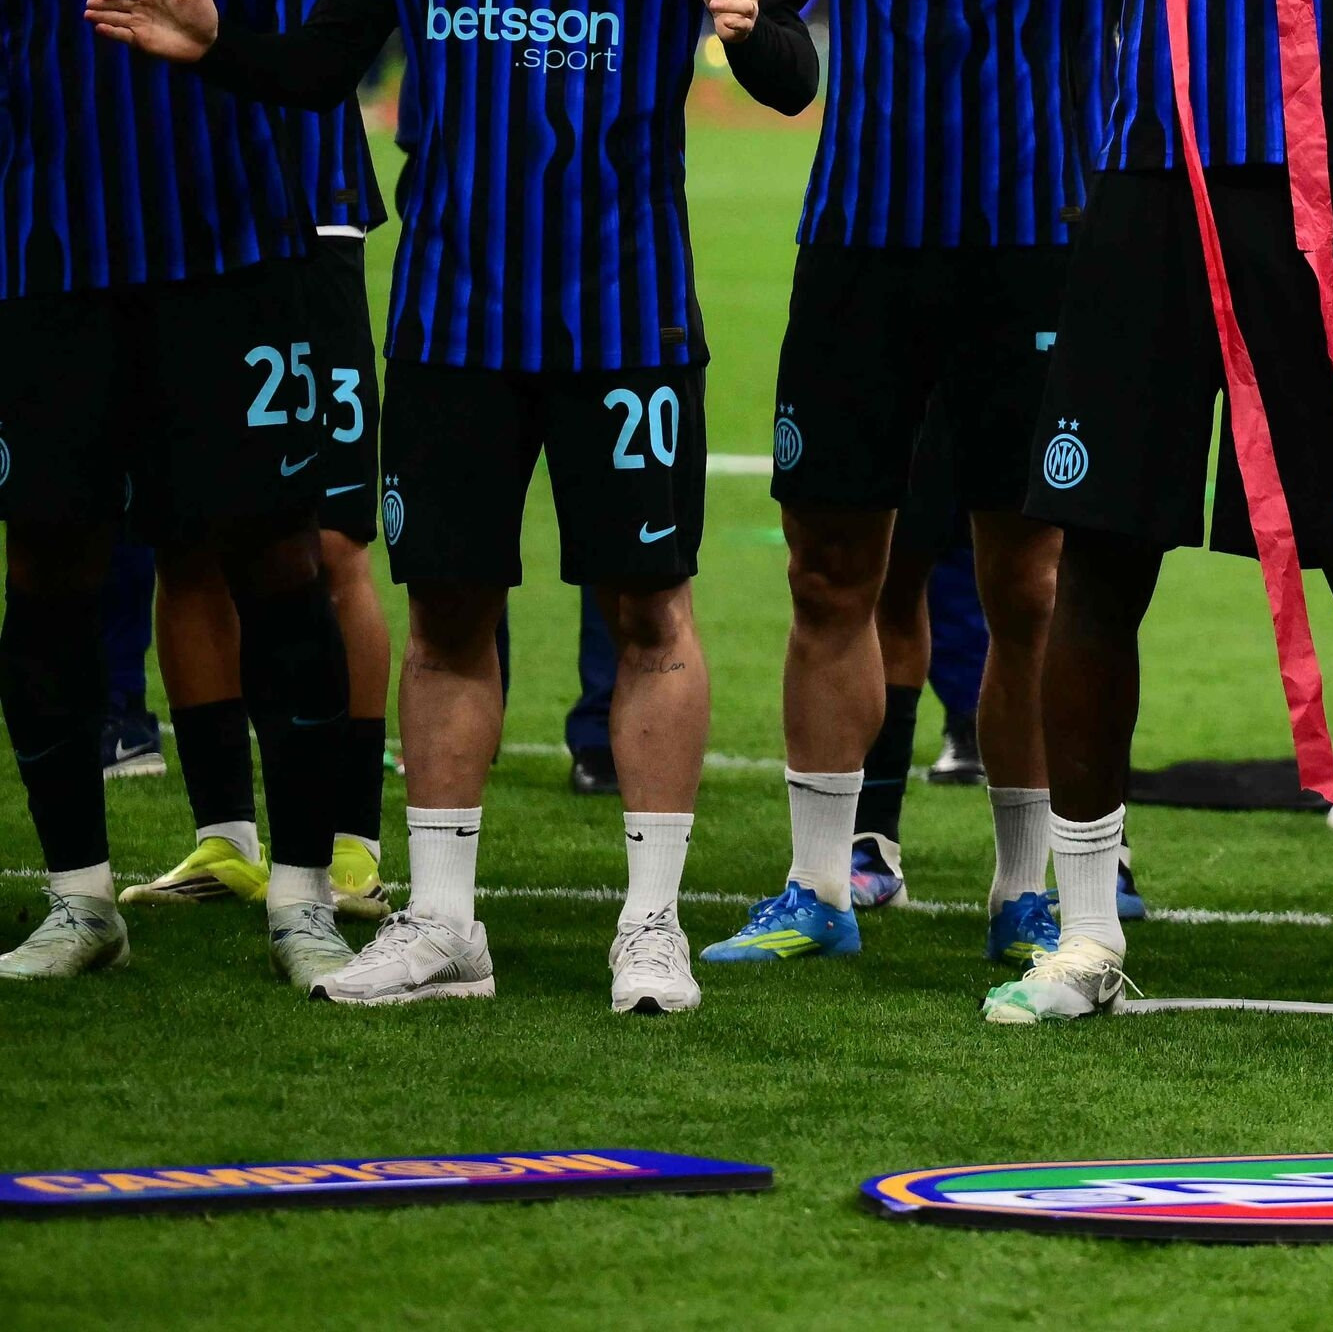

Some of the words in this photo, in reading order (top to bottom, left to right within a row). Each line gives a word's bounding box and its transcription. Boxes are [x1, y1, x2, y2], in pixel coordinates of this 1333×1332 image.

[514, 45, 618, 74] .sport
[245, 342, 316, 426] 25
[323, 368, 364, 443] 3
[604, 386, 679, 470] 20
